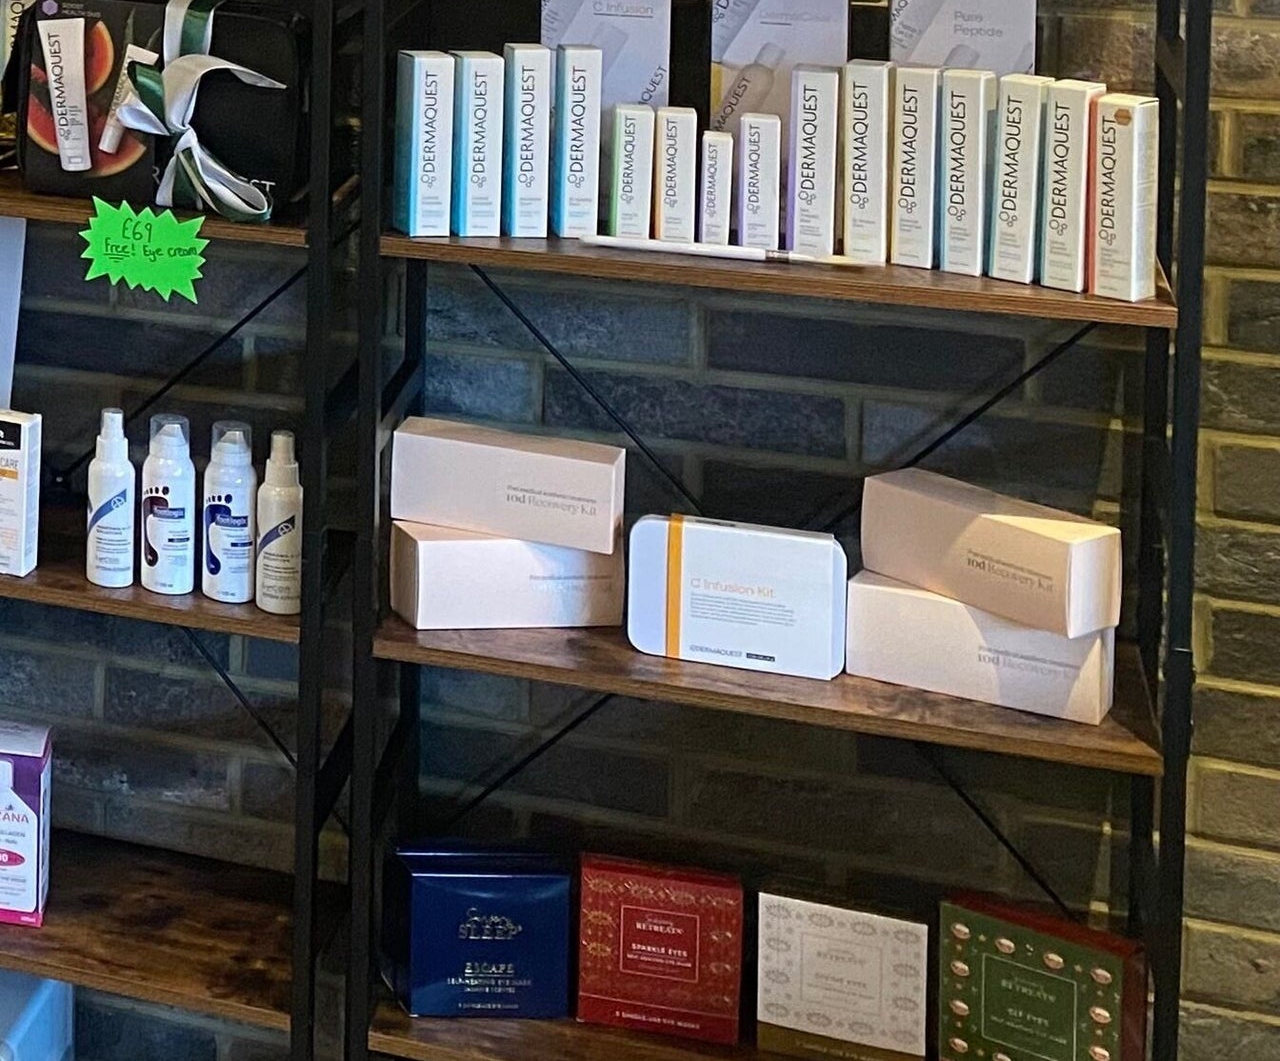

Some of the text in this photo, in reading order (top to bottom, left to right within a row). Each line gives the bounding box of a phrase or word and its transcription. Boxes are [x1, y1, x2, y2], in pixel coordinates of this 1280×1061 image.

[606, 2, 654, 14] Infusion
[48, 32, 68, 127] DERMAQUEST
[422, 70, 438, 173] DERMAQUEST
[472, 71, 488, 173] DERMAQUEST
[520, 66, 535, 172] DERMAQUEST
[569, 66, 587, 173] DERMAQUEST
[621, 115, 637, 195] DERMAQUEST
[664, 119, 678, 198] DERMAQUEST
[706, 143, 717, 210] DERMAQUEST
[748, 123, 760, 205] DERMAQUEST
[801, 84, 818, 191] DERMAQUEST
[852, 82, 868, 196] DERMAQUEST
[900, 85, 919, 200] DERMAQUEST
[949, 91, 967, 207] DERMAQUEST
[1001, 96, 1023, 213] DERMAQUEST
[1051, 102, 1070, 221] DERMAQUEST
[1100, 116, 1118, 229] DERMAQUEST
[105, 237, 198, 262] Free! Eye cream
[528, 496, 579, 515] Recovery
[581, 504, 597, 516] Kit
[703, 579, 755, 596] Infusion
[757, 585, 775, 598] Kit
[988, 564, 1036, 589] Recovery
